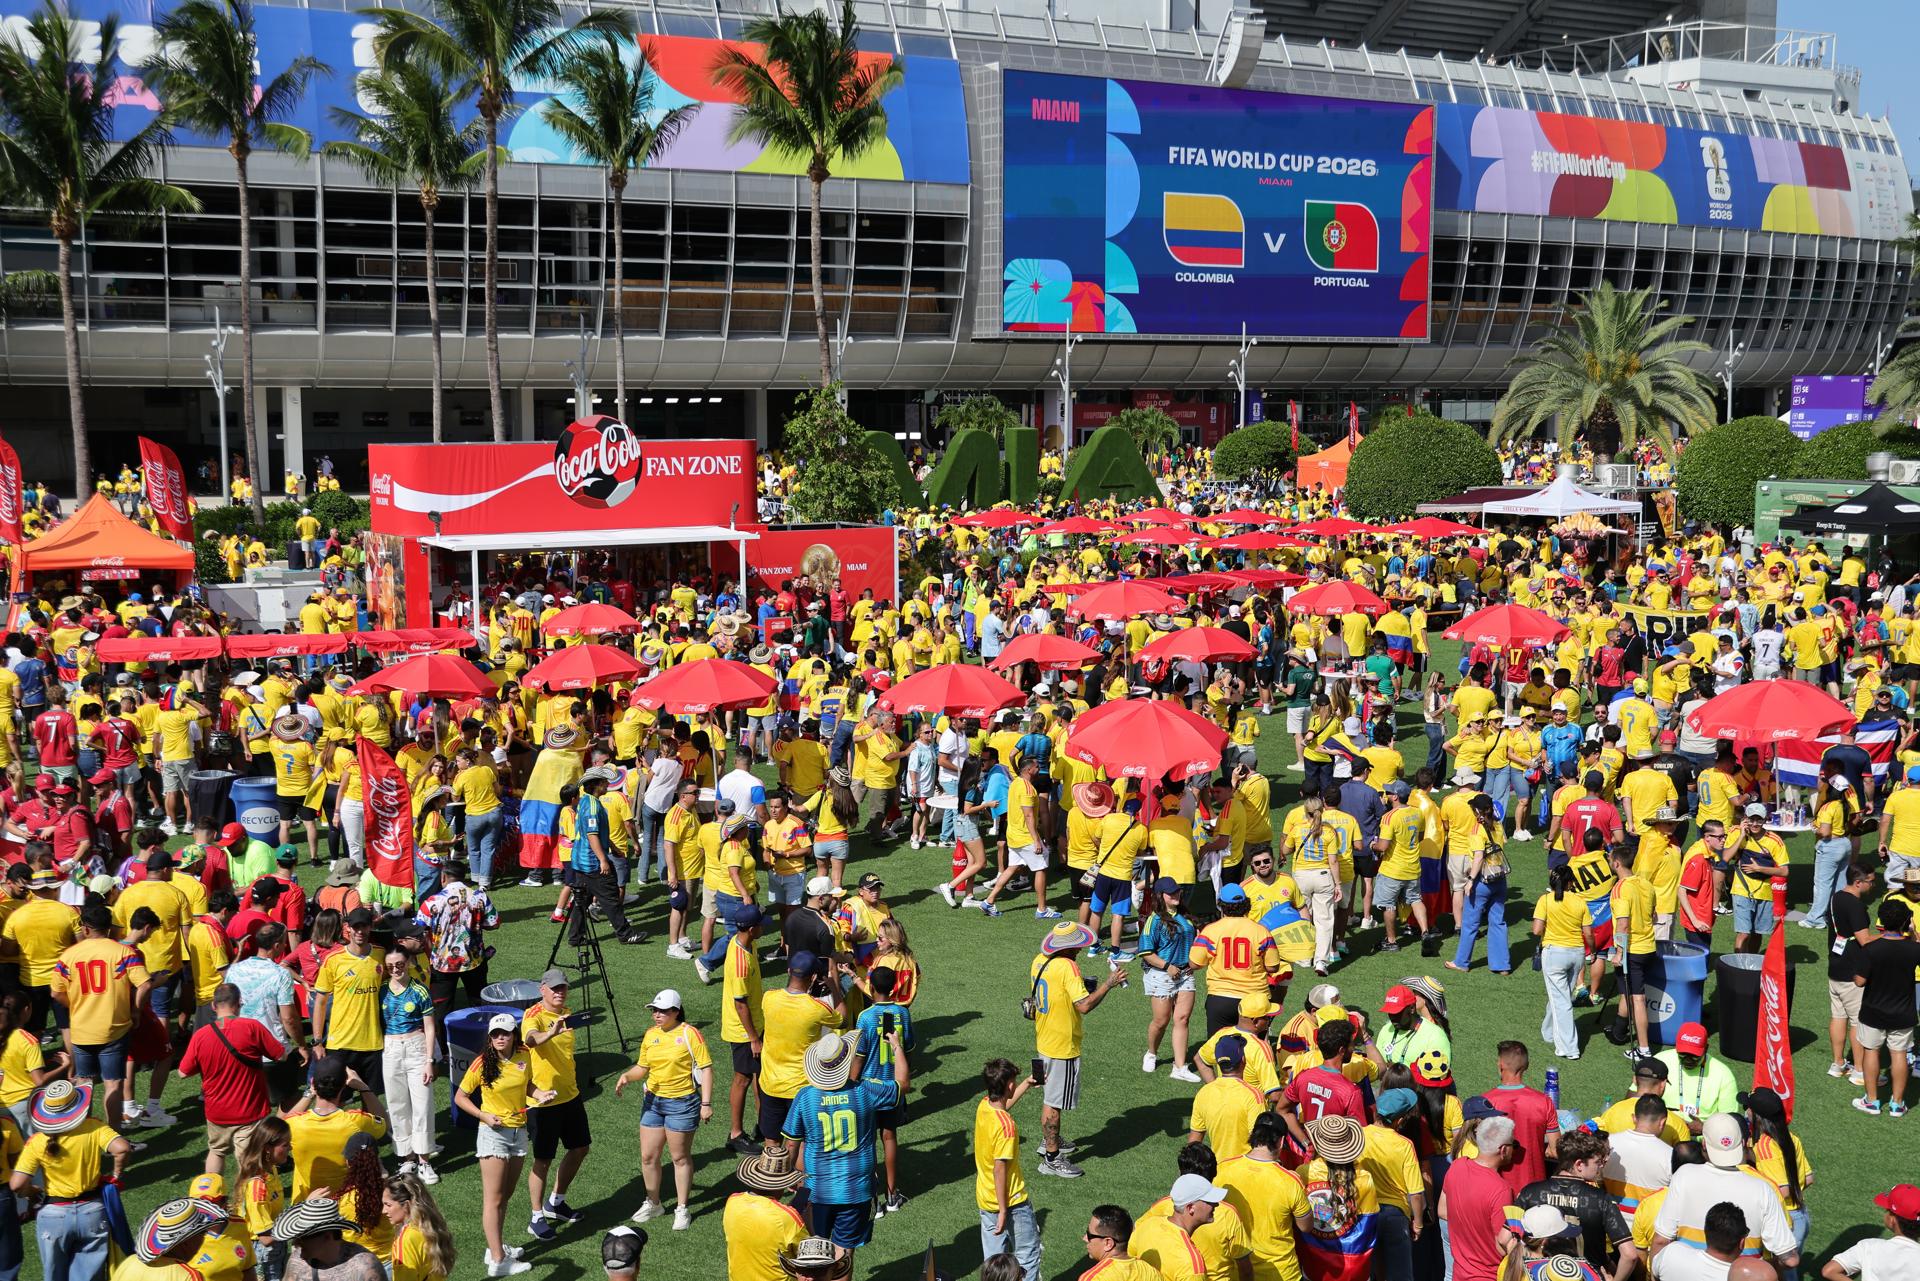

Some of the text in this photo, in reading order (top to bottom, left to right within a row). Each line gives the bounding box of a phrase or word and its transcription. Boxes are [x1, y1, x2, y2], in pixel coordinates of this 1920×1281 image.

[1032, 98, 1080, 123] MIAMI
[1168, 146, 1377, 177] FIFA WORLD CUP 2026
[1531, 150, 1626, 184] #FIFAWorldCup
[1258, 177, 1293, 187] MIAMI
[1709, 209, 1733, 221] 2026
[1175, 272, 1370, 288] COLOMBIA PORTUGAL
[555, 422, 742, 496] Coca-Cola FAN ZONE
[147, 460, 171, 515] Coca-Cola
[1816, 522, 1829, 530] Keep
[92, 556, 125, 567] Coca-Cola
[759, 563, 867, 575] FAN ZONE MIAMI
[517, 617, 529, 631] 10
[149, 651, 172, 659] Coca-Cola
[276, 646, 299, 654] Coca-Cola
[1510, 649, 1522, 665] 17
[1762, 643, 1770, 658] 7
[562, 680, 582, 688] Coca-Cola
[684, 704, 706, 712] Coca-Cola
[962, 707, 985, 716] Coca-Cola
[1626, 712, 1635, 733] 7
[47, 722, 57, 743] 7
[114, 729, 124, 751] 7
[1718, 728, 1737, 737] Coca-Cola
[1772, 730, 1798, 738] Coca-Cola
[1122, 765, 1147, 776] Coca-Cola
[1186, 760, 1209, 773] Coca-Cola
[242, 815, 280, 825] RECYCLE
[370, 773, 404, 860] Coca-Cola
[1582, 815, 1593, 831] 7
[1408, 825, 1418, 848] 7
[1303, 836, 1325, 862] 10
[1221, 937, 1252, 970] 10
[74, 959, 107, 995] 10
[878, 1013, 901, 1024] JES
[1681, 1033, 1701, 1044] Coca-Cola
[1761, 975, 1791, 1100] Coca-Cola
[820, 1094, 849, 1107] JAMES
[1311, 1097, 1325, 1119] 7
[818, 1109, 858, 1153] 10
[1547, 1193, 1578, 1208] VITINHA
